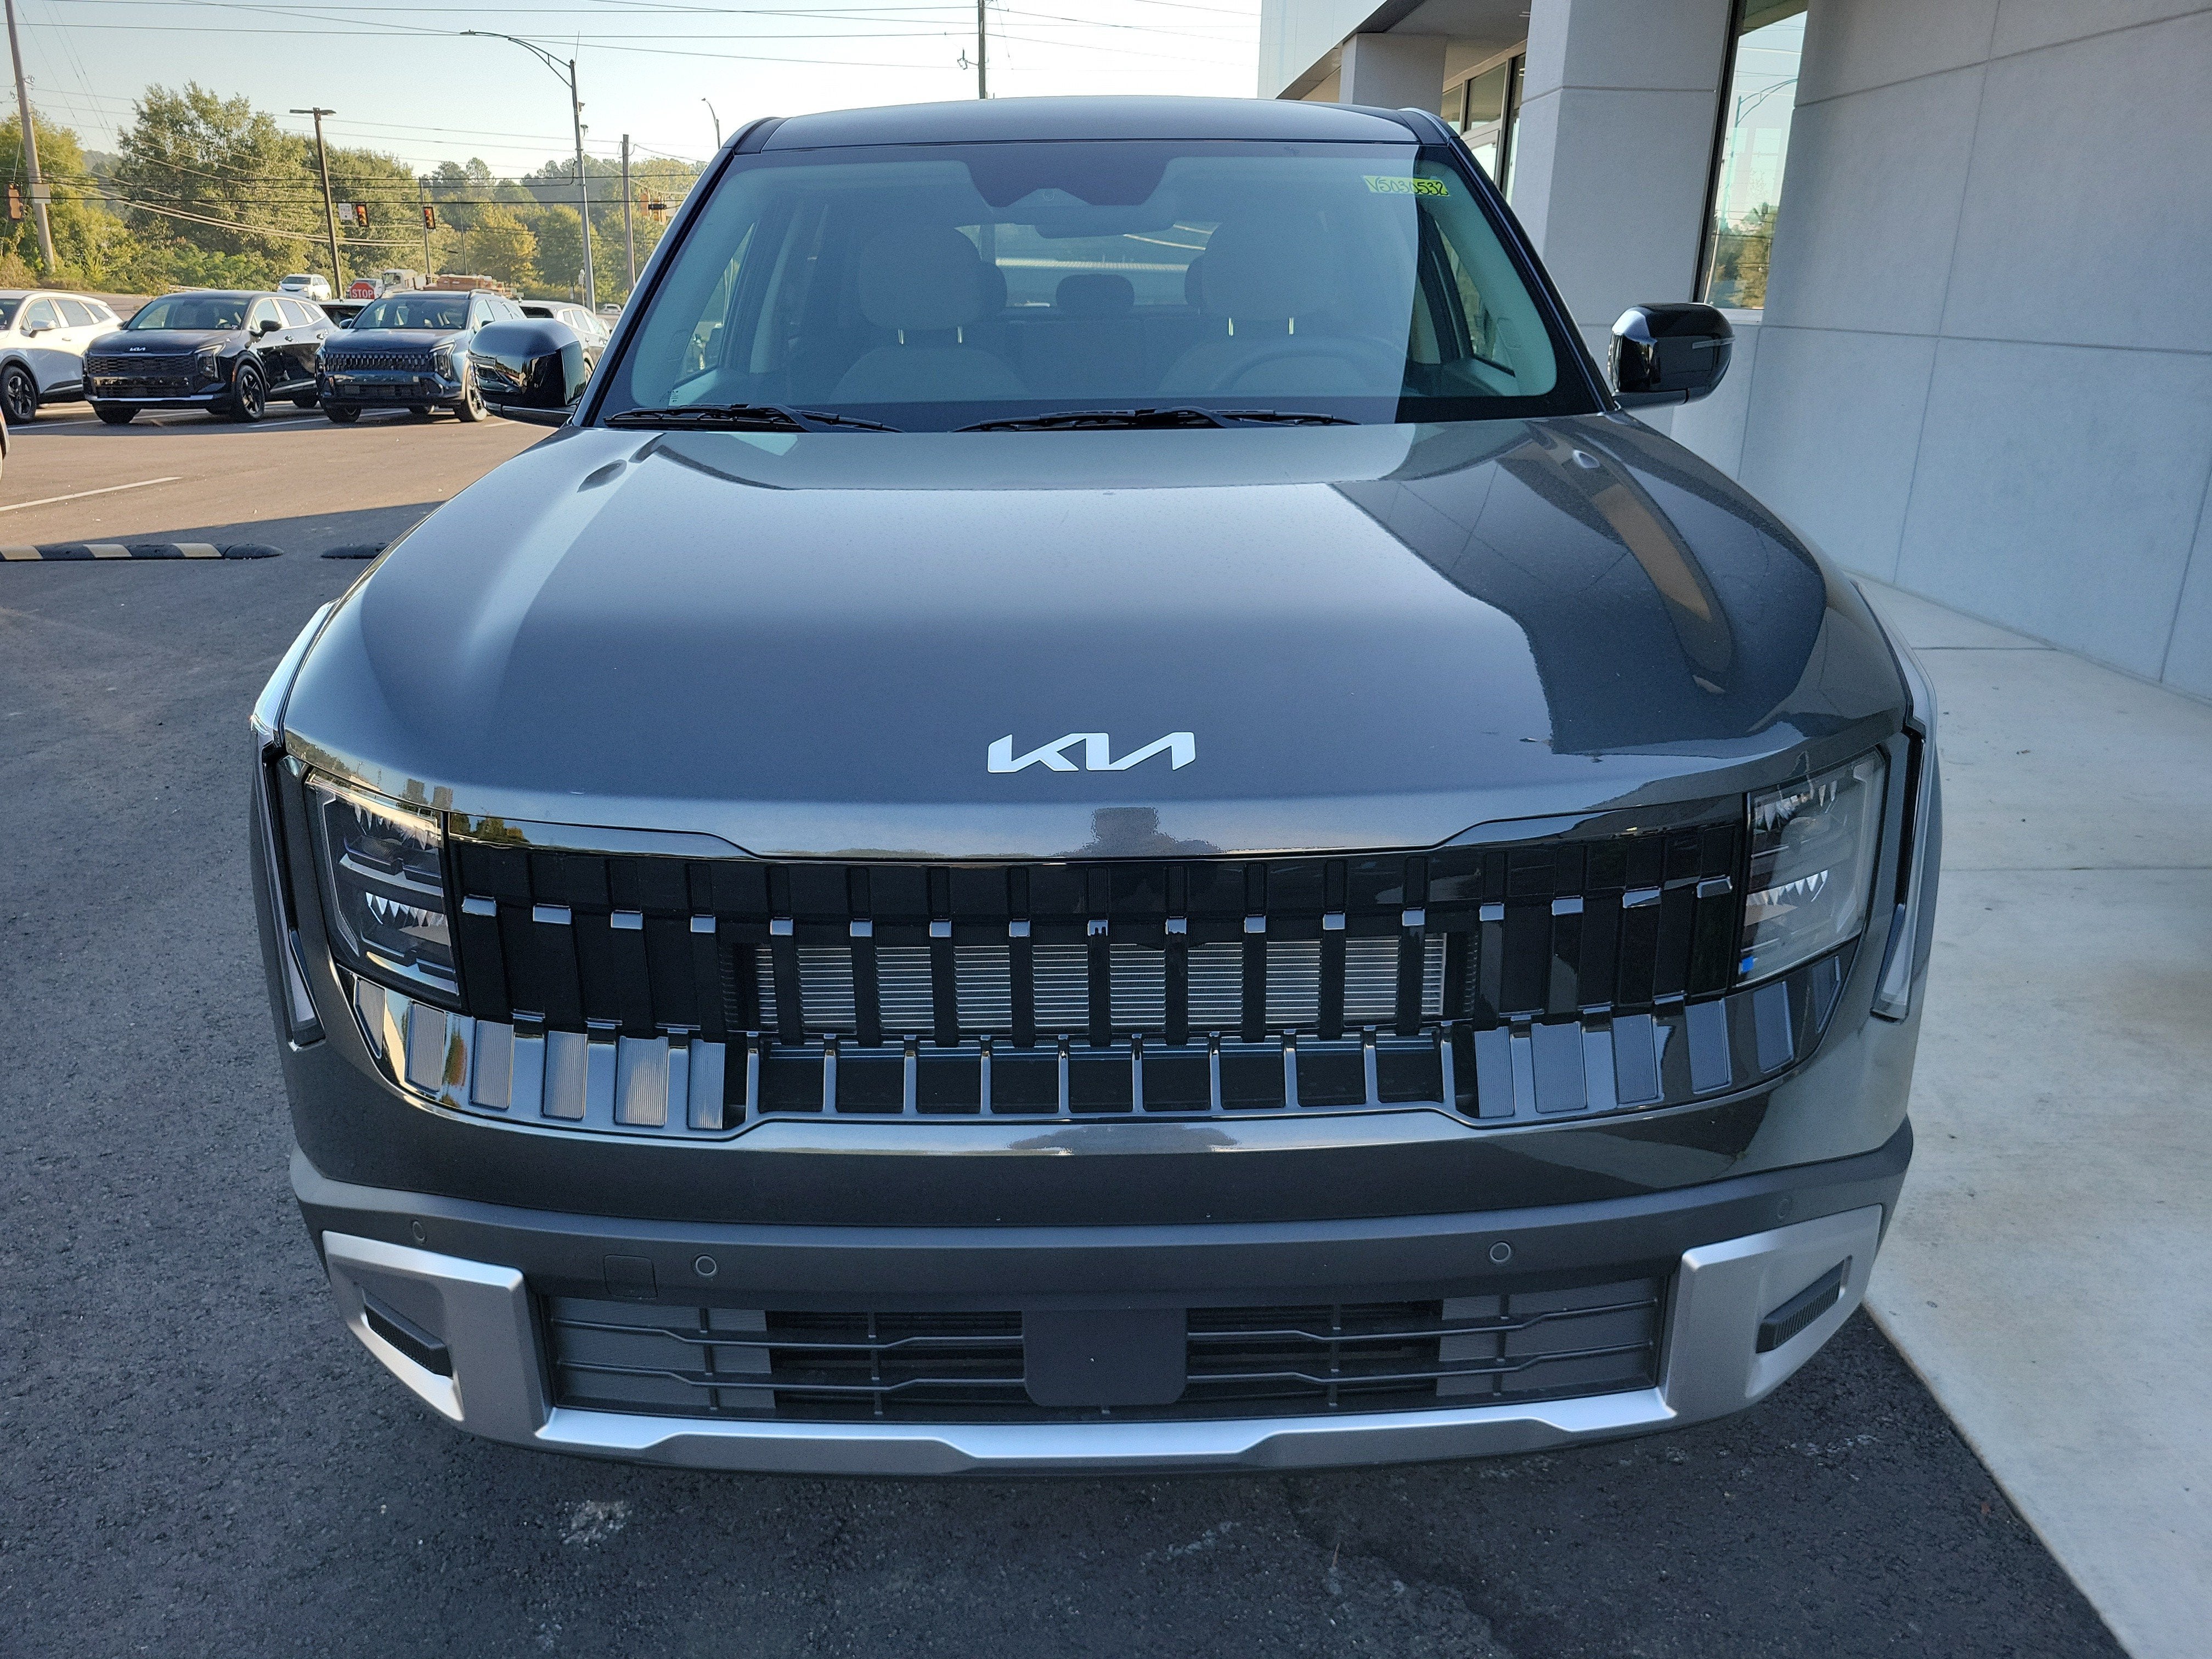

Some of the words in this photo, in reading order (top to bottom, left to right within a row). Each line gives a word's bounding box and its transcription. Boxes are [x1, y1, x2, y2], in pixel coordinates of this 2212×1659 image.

[1364, 177, 1449, 195] V5030532
[352, 289, 373, 298] STOP
[988, 732, 1196, 773] KIA
